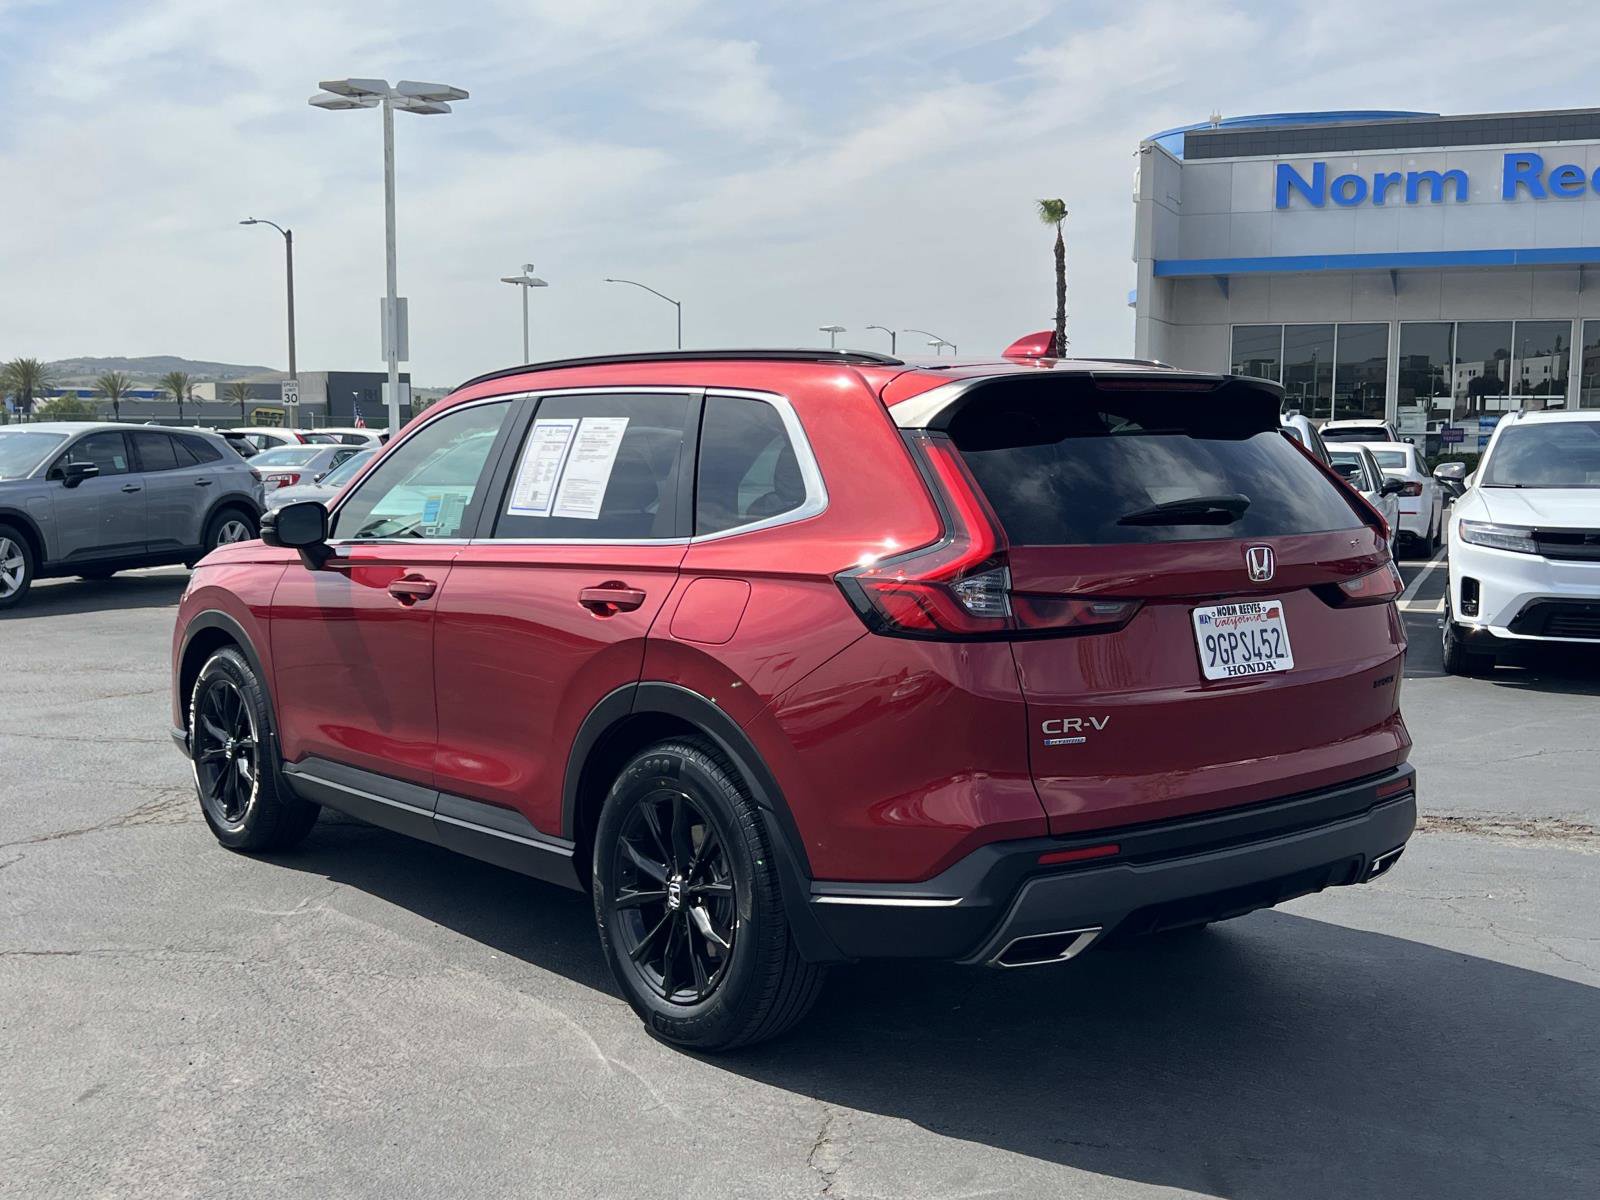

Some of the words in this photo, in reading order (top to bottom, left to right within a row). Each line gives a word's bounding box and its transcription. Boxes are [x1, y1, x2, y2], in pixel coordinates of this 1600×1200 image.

[1276, 162, 1469, 209] Norm
[1502, 152, 1600, 201] Re
[284, 393, 298, 403] 30
[255, 411, 284, 419] BEST
[256, 418, 281, 427] BUY
[1216, 605, 1238, 617] NORM
[1239, 603, 1262, 615] REEVES
[1214, 613, 1264, 630] California
[1205, 627, 1285, 667] 9GPS452
[1226, 661, 1276, 676] HONDA
[1041, 715, 1110, 734] CR-V
